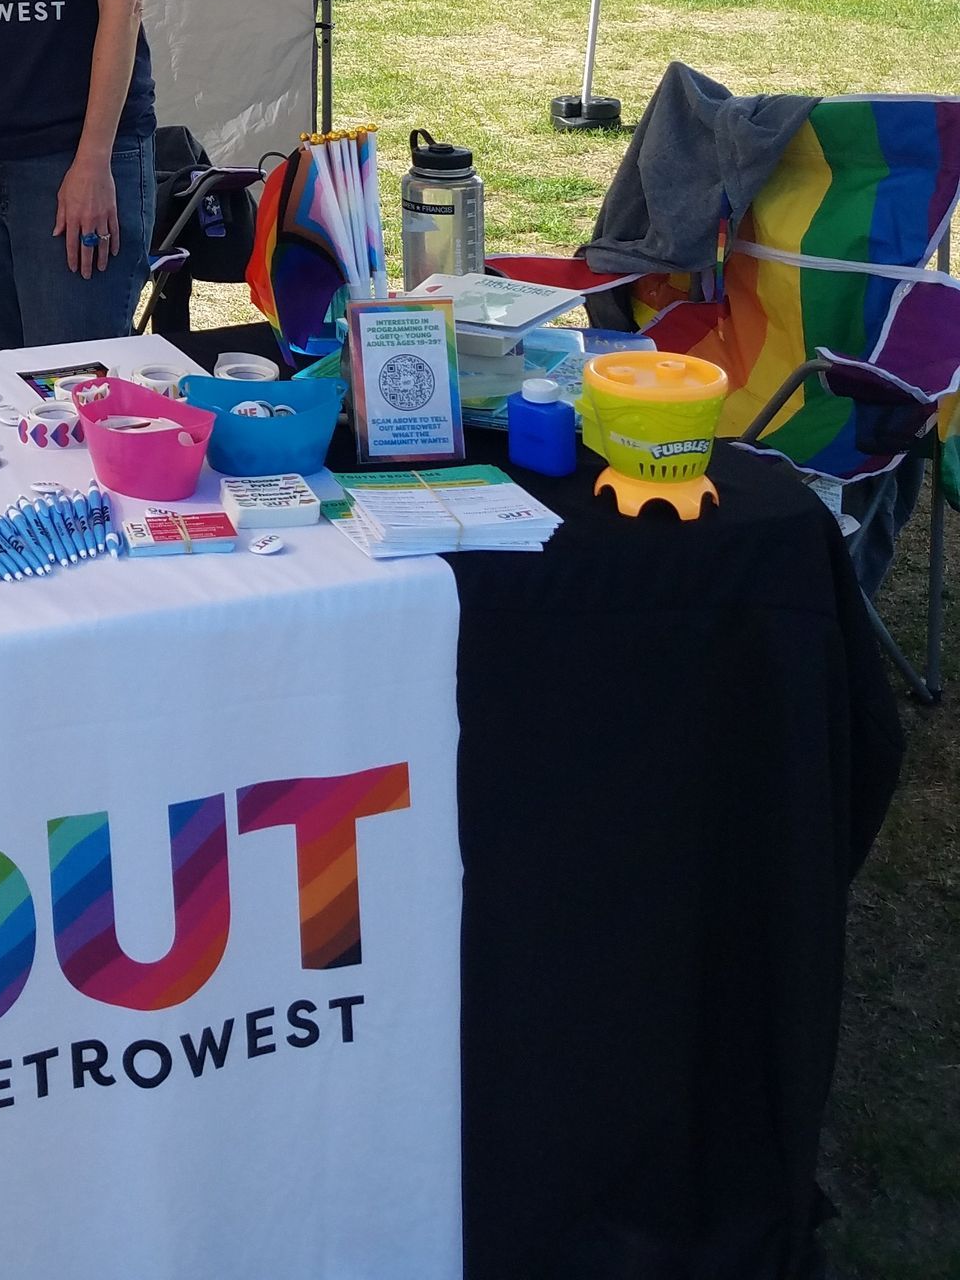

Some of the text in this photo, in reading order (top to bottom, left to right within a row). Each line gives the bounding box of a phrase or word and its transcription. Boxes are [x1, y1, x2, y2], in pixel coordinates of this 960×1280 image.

[421, 205, 453, 214] FRANCIS
[651, 440, 711, 458] FUBBLES
[148, 507, 180, 518] OUT
[498, 509, 534, 520] OUT
[130, 523, 146, 538] OUT
[256, 535, 280, 550] OUT
